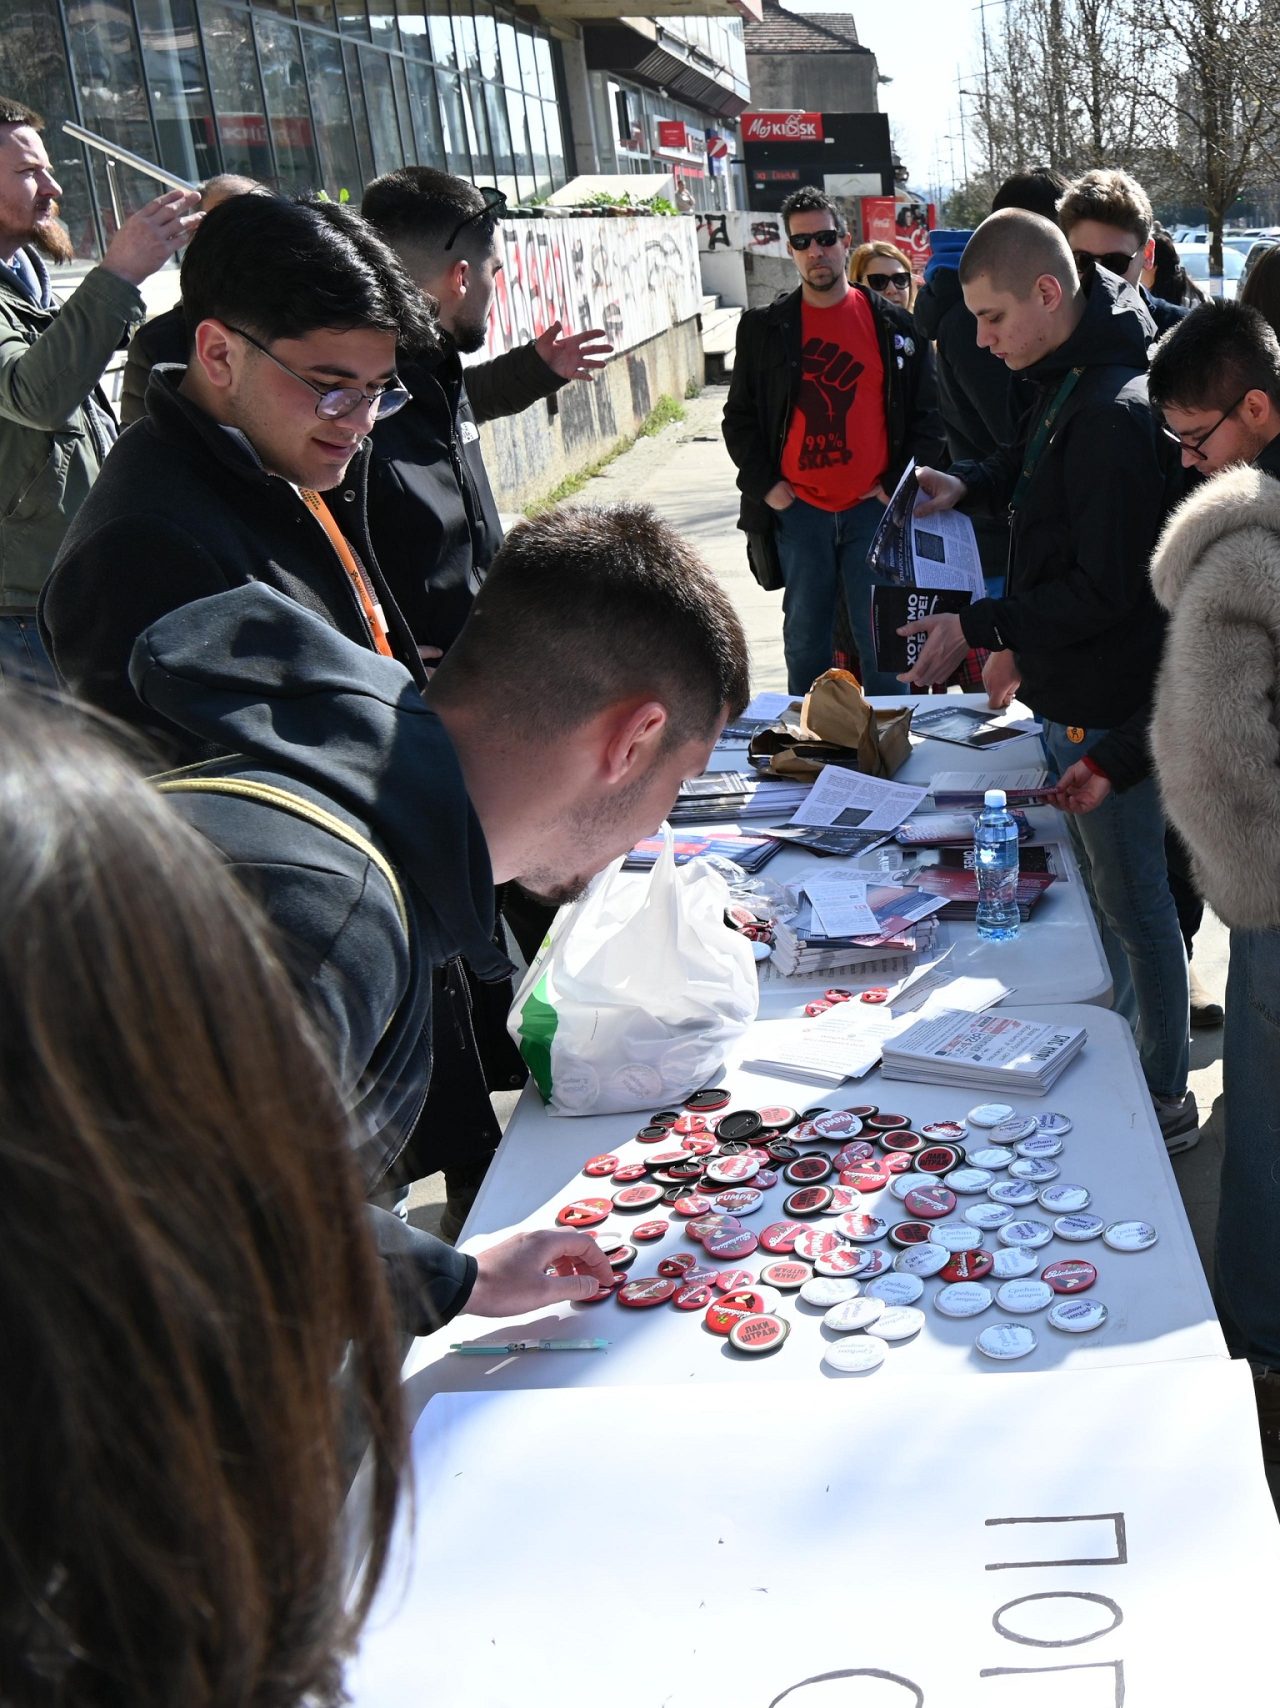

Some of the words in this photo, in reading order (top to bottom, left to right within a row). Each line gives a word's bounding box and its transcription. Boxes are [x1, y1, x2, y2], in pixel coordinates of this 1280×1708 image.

[748, 118, 771, 138] Moj
[772, 115, 816, 136] KIOSK
[805, 432, 843, 451] 99%
[817, 1113, 852, 1130] PUMPAJ
[714, 1191, 760, 1201] PUMPAJ
[745, 1320, 770, 1334] ЛАКИ
